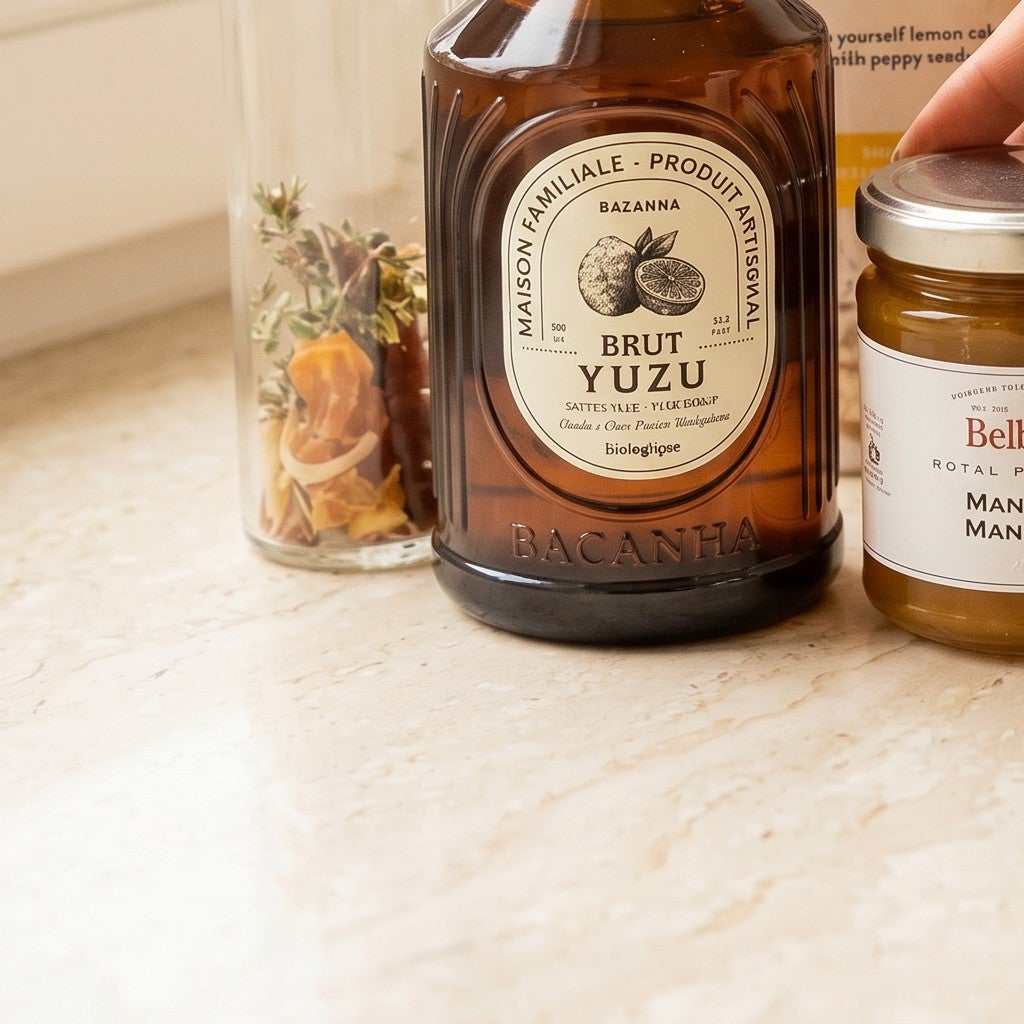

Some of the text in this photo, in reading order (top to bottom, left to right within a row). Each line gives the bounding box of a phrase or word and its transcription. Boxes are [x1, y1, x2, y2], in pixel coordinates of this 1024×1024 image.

[837, 26, 906, 49] yourself
[910, 26, 963, 41] lemon
[871, 54, 922, 71] peppy
[650, 153, 743, 203] PRODUIT
[522, 155, 624, 233] FAMILIALE
[599, 198, 681, 213] BAZANNA
[517, 238, 535, 337] MAISON
[551, 323, 567, 332] 500
[601, 331, 683, 357] BRUT
[578, 360, 706, 393] YUZU
[932, 458, 999, 476] ROTAL
[511, 516, 761, 566] BACANHA
